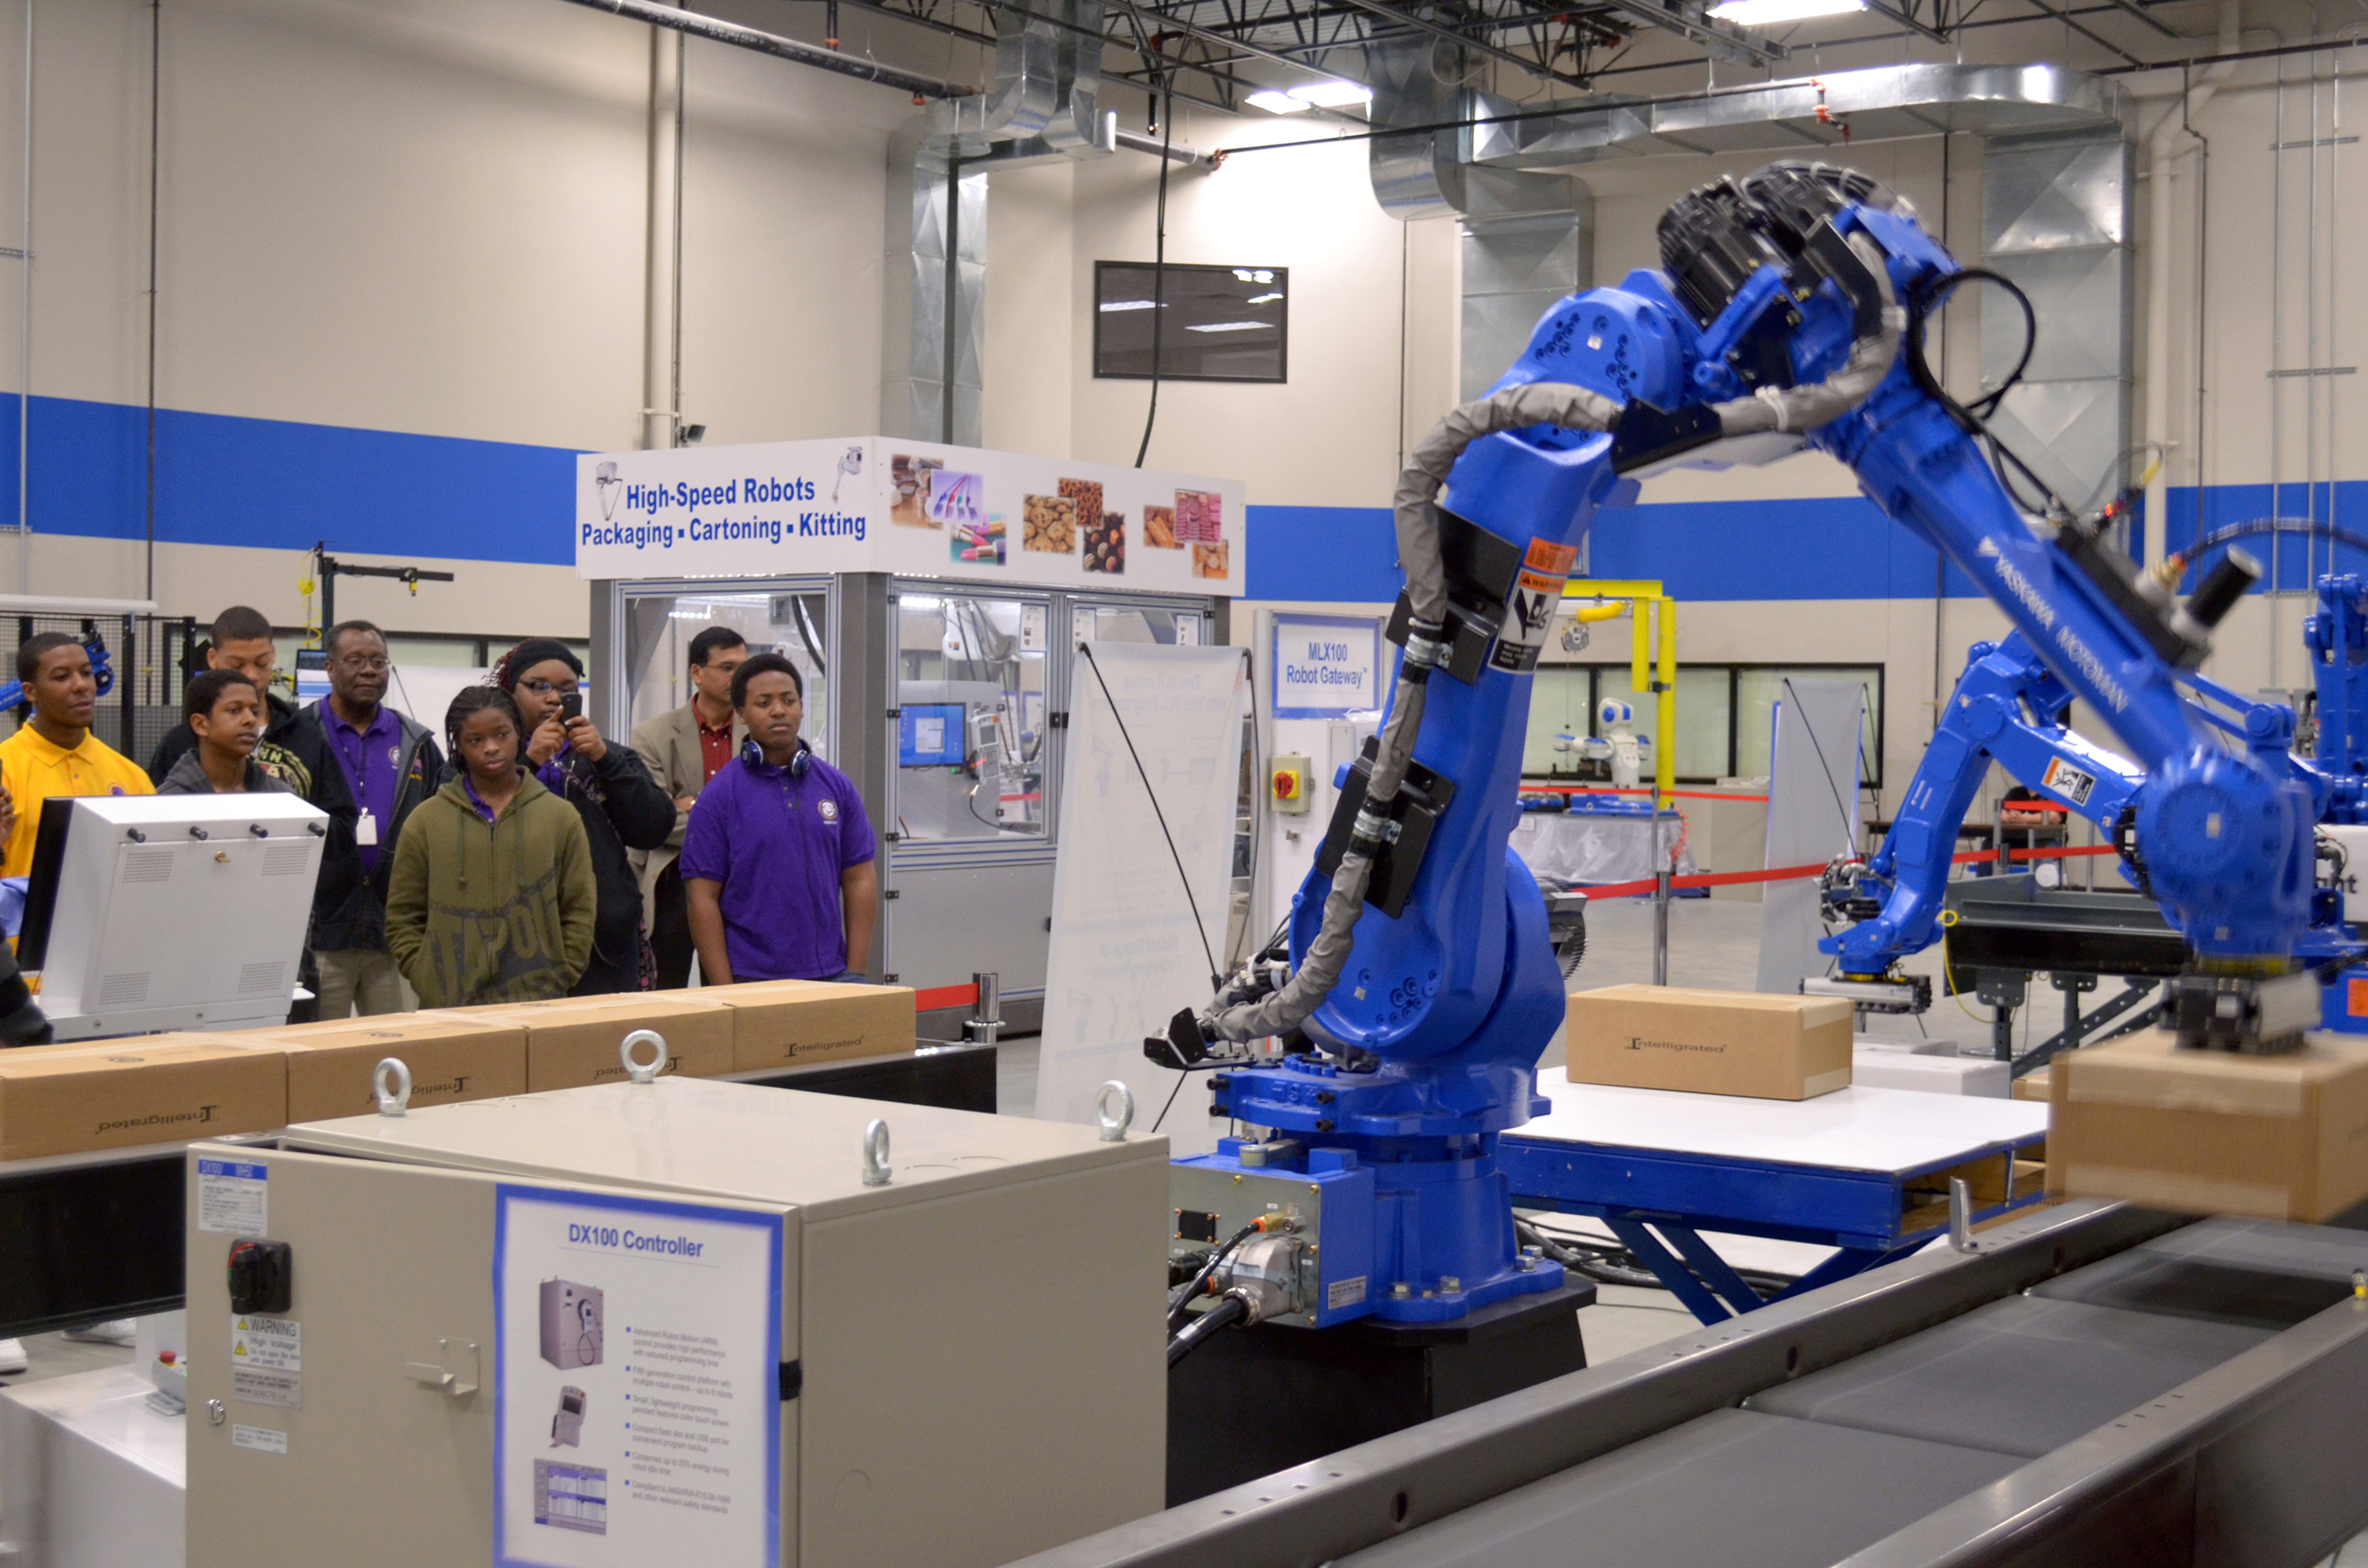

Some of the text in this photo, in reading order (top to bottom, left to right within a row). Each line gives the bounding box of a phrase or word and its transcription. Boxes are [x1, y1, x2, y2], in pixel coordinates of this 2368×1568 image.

[626, 476, 815, 515] High-Speed Robots
[582, 511, 866, 550] Packaging Cartoning Kitting
[1994, 552, 2054, 632] YASKAWA
[1308, 642, 1348, 661] MLX100
[1287, 665, 1318, 684] Robot
[2056, 625, 2128, 714] MOTOMAN
[784, 1035, 863, 1058] Intelligrated
[1624, 1036, 1727, 1053] Intelligrated
[96, 1105, 220, 1135] Intelligrated
[569, 1223, 703, 1257] DX100 Controller
[250, 1318, 296, 1336] WARNING
